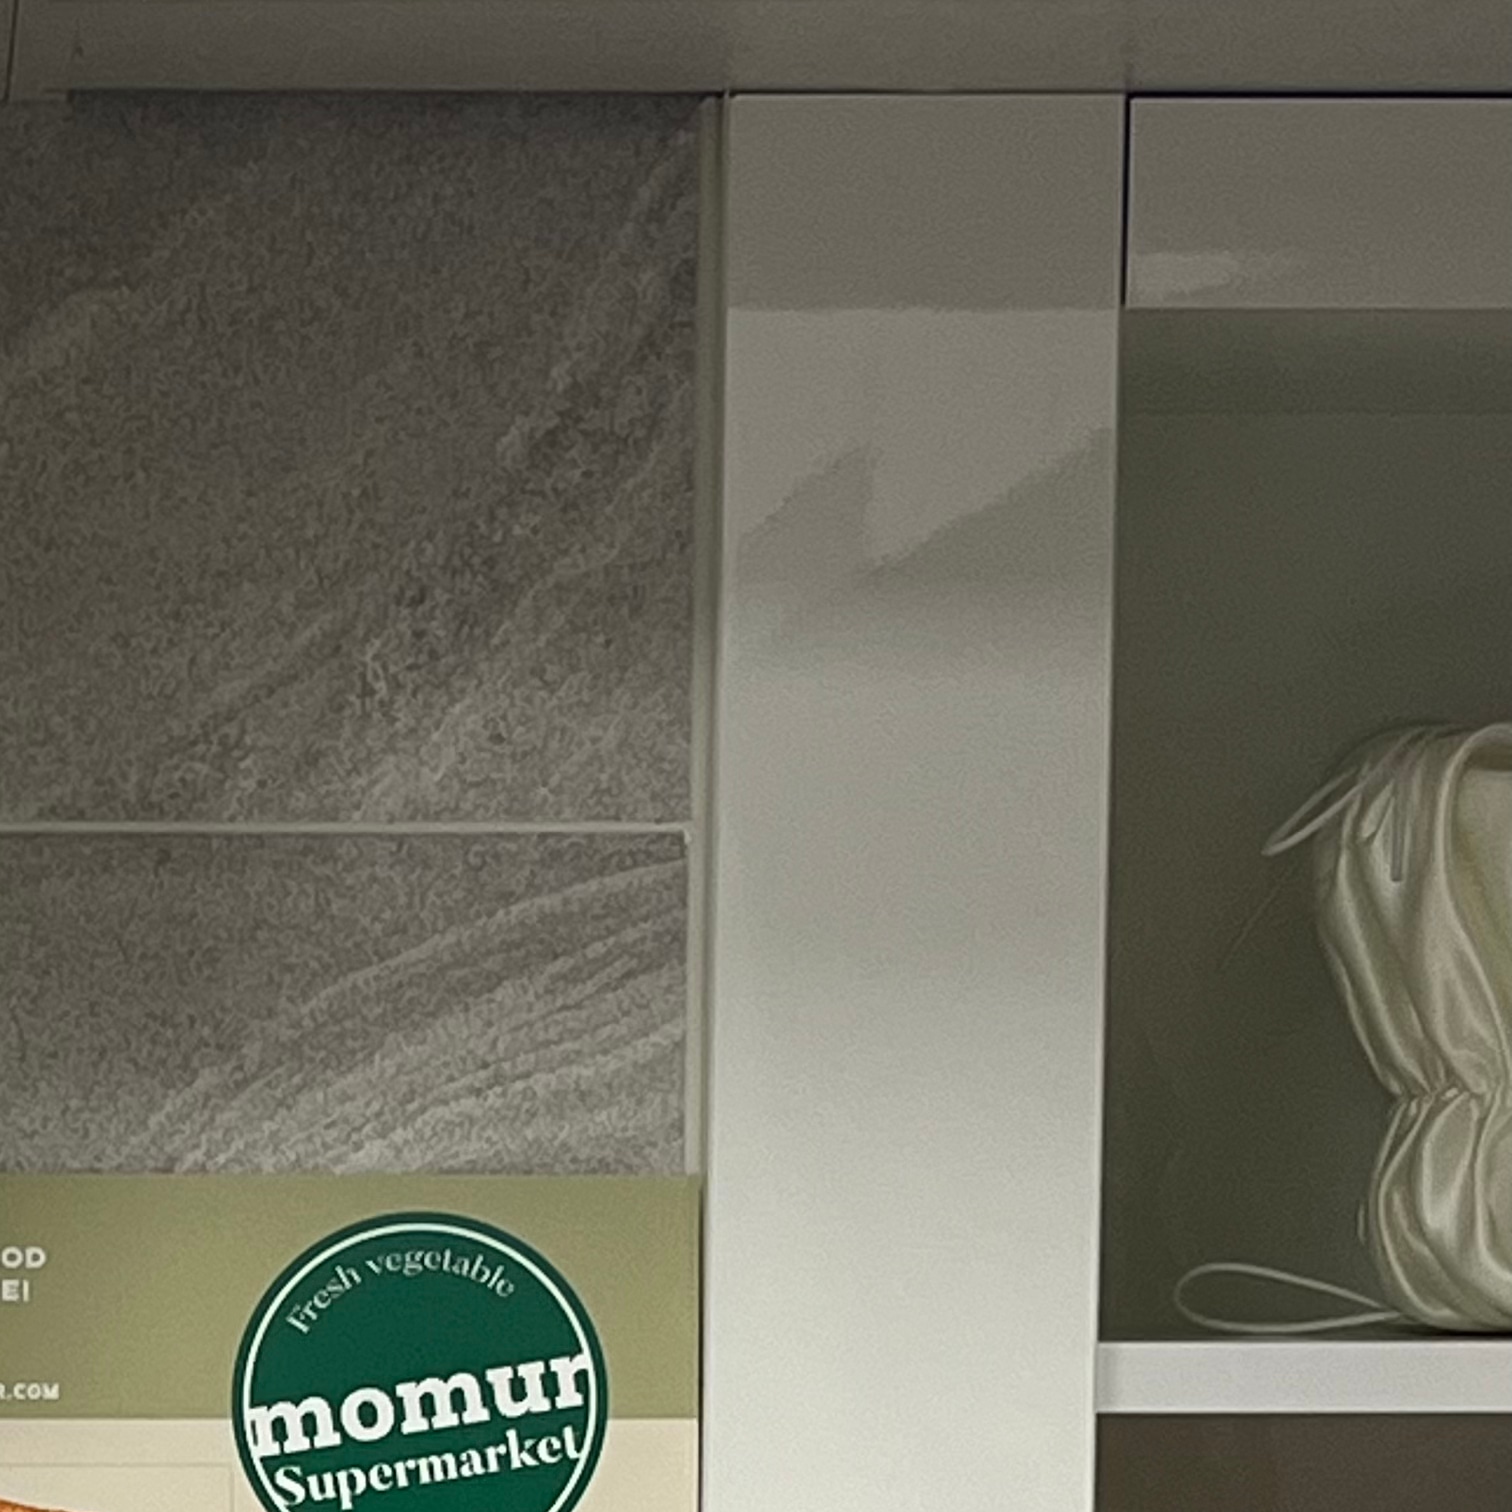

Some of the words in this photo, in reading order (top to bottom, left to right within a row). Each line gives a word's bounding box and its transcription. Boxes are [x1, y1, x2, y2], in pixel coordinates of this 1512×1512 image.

[285, 1263, 362, 1335] Fresh
[365, 1248, 516, 1299] vegetable
[247, 1351, 592, 1458] momur
[274, 1425, 581, 1511] Supermarket
